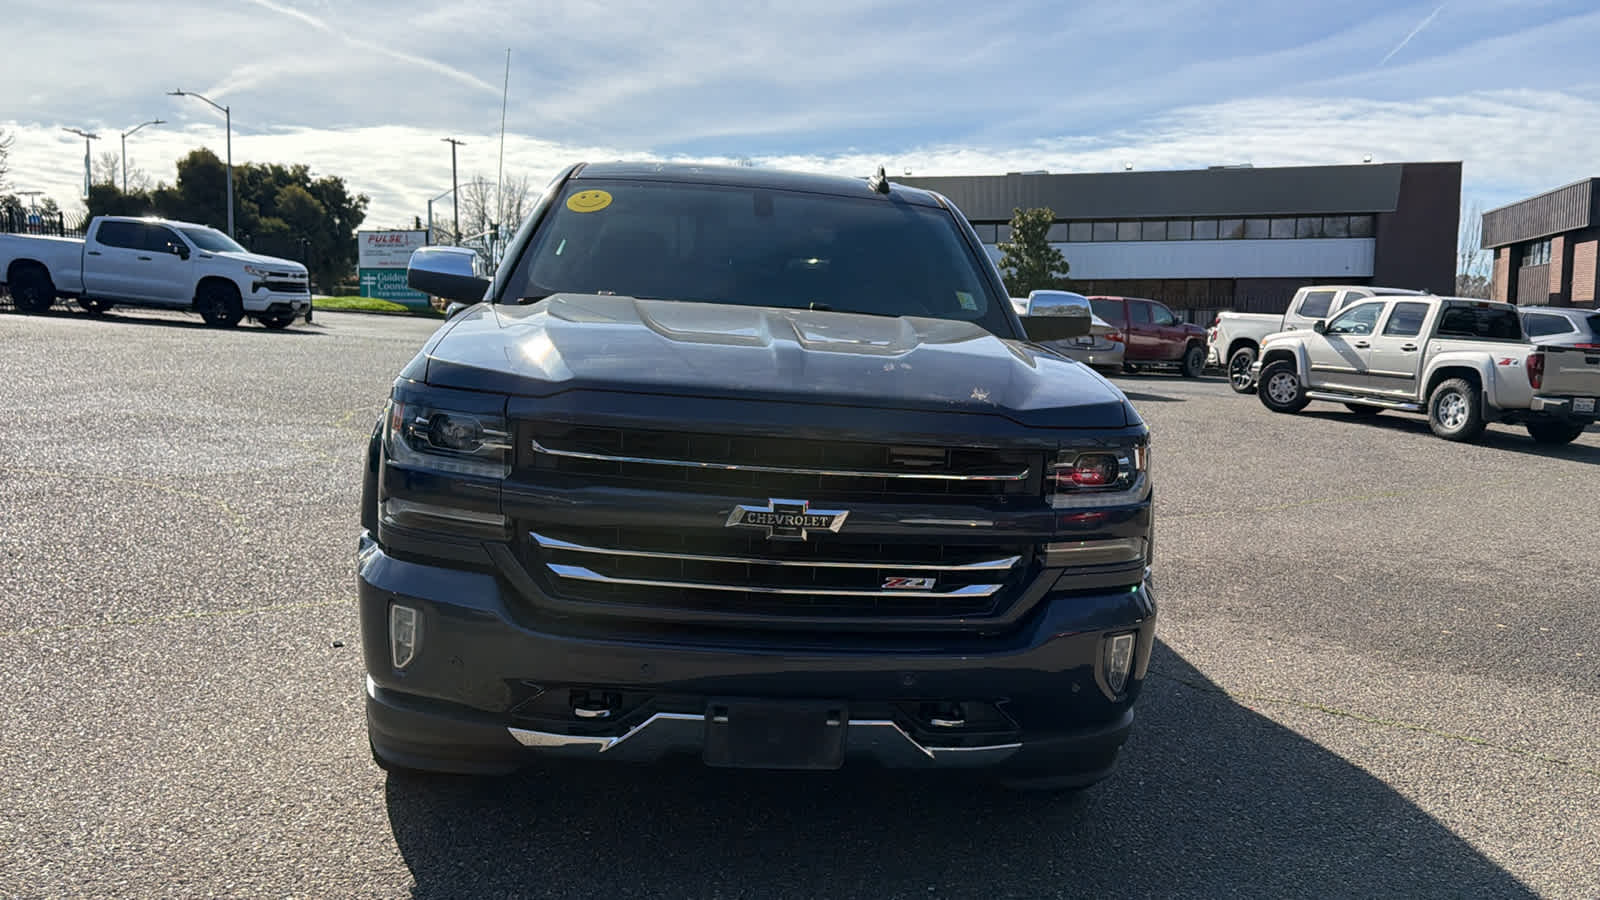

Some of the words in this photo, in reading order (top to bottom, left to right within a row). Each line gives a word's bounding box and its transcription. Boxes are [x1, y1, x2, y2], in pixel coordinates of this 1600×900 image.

[368, 234, 401, 243] PULSE
[377, 272, 408, 282] Guidep
[747, 513, 829, 527] CHEVROLET
